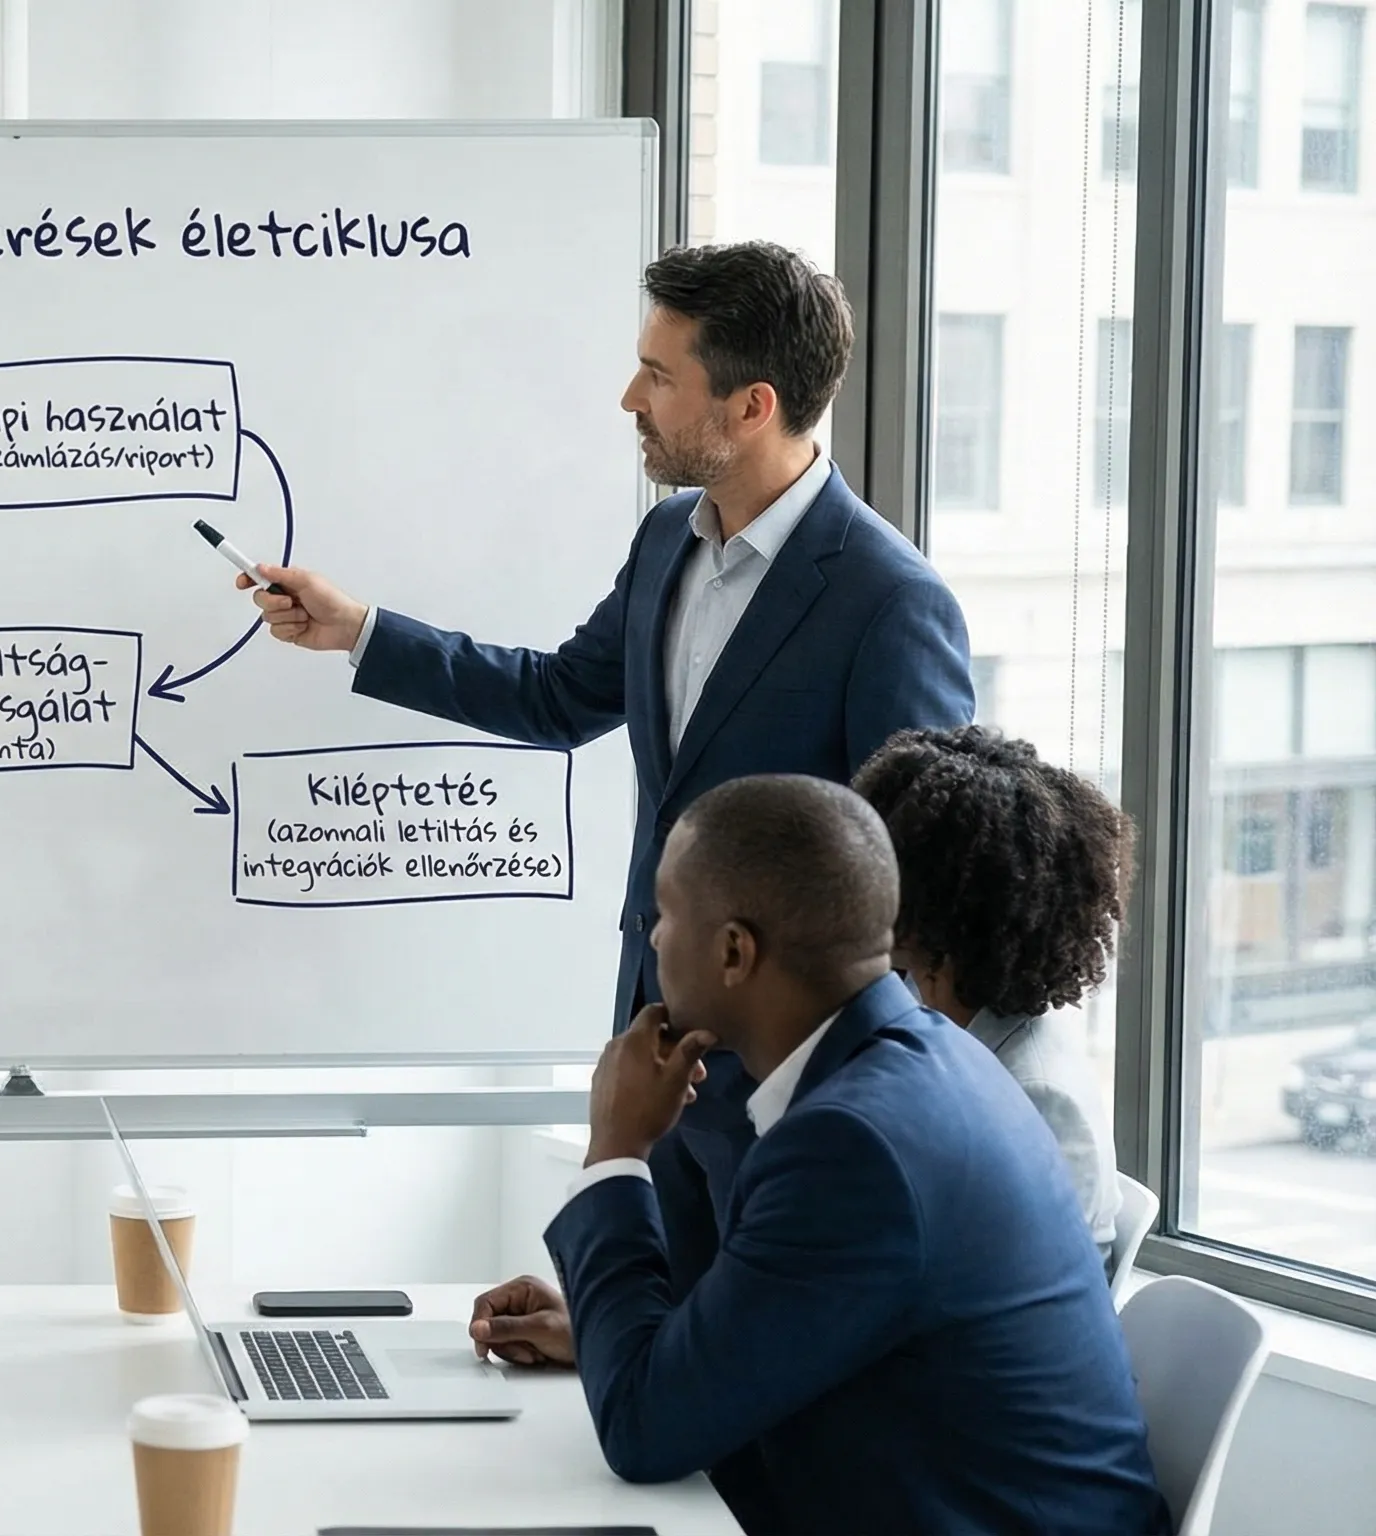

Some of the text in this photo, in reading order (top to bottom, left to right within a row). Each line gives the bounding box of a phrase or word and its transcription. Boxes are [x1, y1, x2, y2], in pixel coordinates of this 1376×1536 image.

[181, 207, 471, 259] életciklusa
[46, 396, 227, 433] használat
[307, 771, 498, 817] Kiléptetés
[267, 816, 538, 844] (azonnali letiltás és
[243, 851, 562, 893] integrációk ellenőrzése)
